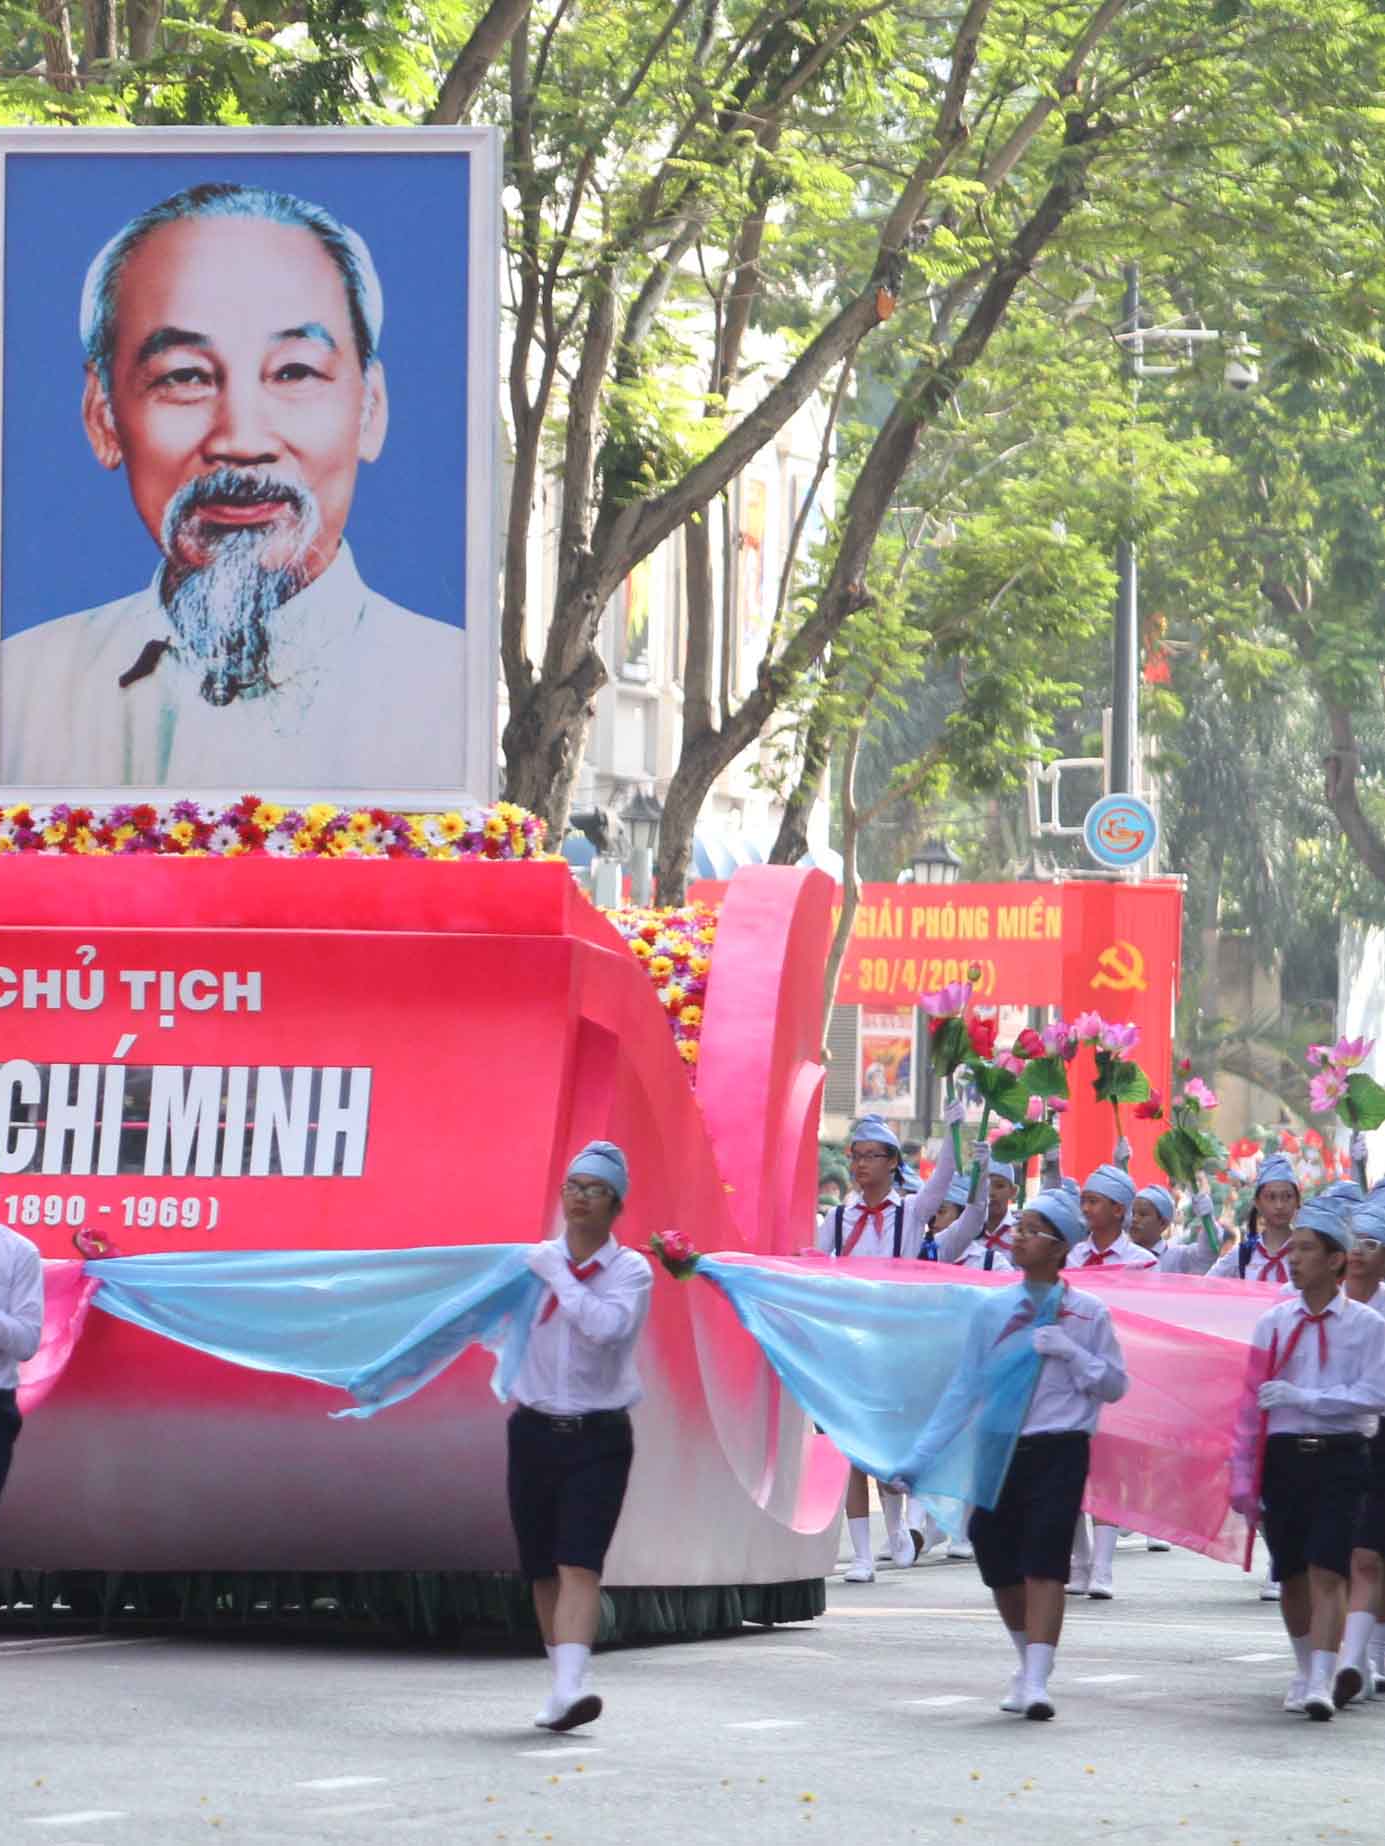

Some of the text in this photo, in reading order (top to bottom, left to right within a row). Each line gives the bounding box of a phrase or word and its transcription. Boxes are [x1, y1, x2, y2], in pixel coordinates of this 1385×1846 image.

[910, 901, 989, 940] PHÓNG
[119, 969, 262, 1028] TỊCH
[143, 1064, 372, 1178] MINH
